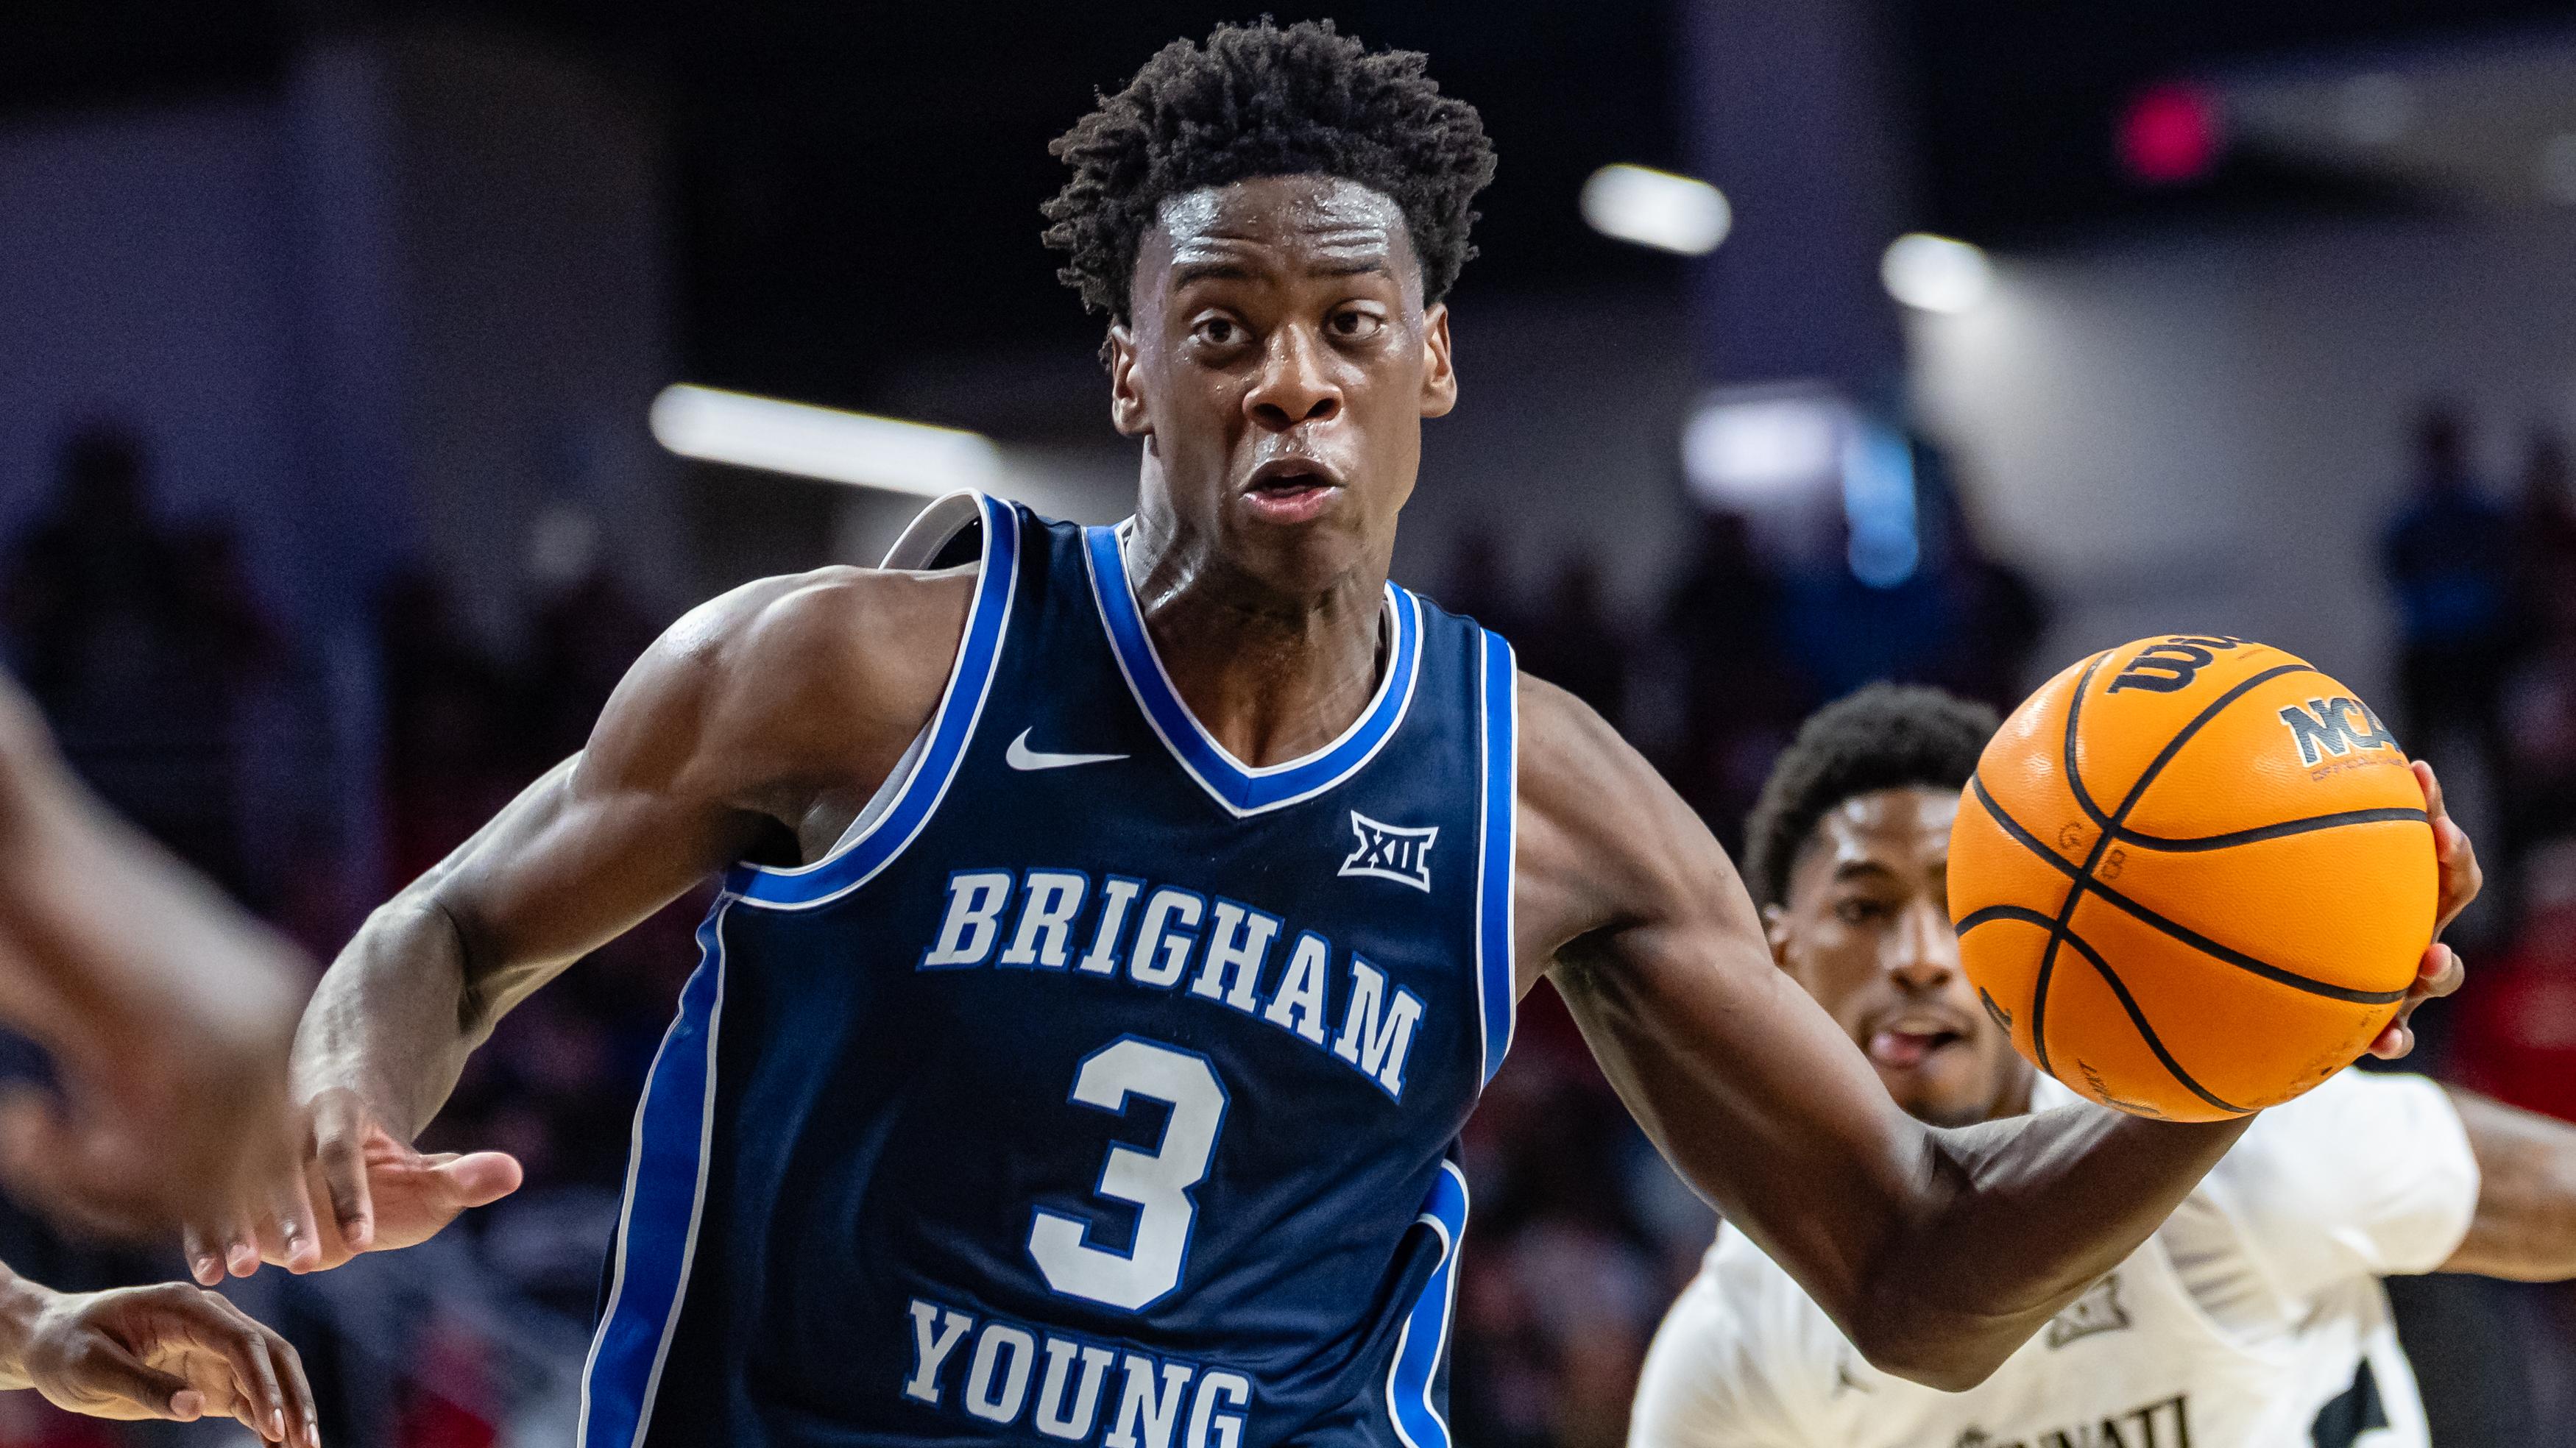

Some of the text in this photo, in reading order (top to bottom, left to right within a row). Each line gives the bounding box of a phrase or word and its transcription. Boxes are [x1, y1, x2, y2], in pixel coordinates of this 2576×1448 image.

[917, 868, 1428, 1104] BRIGHAM
[1026, 1034, 1230, 1313] 3
[904, 1298, 1254, 1448] YOUNG
